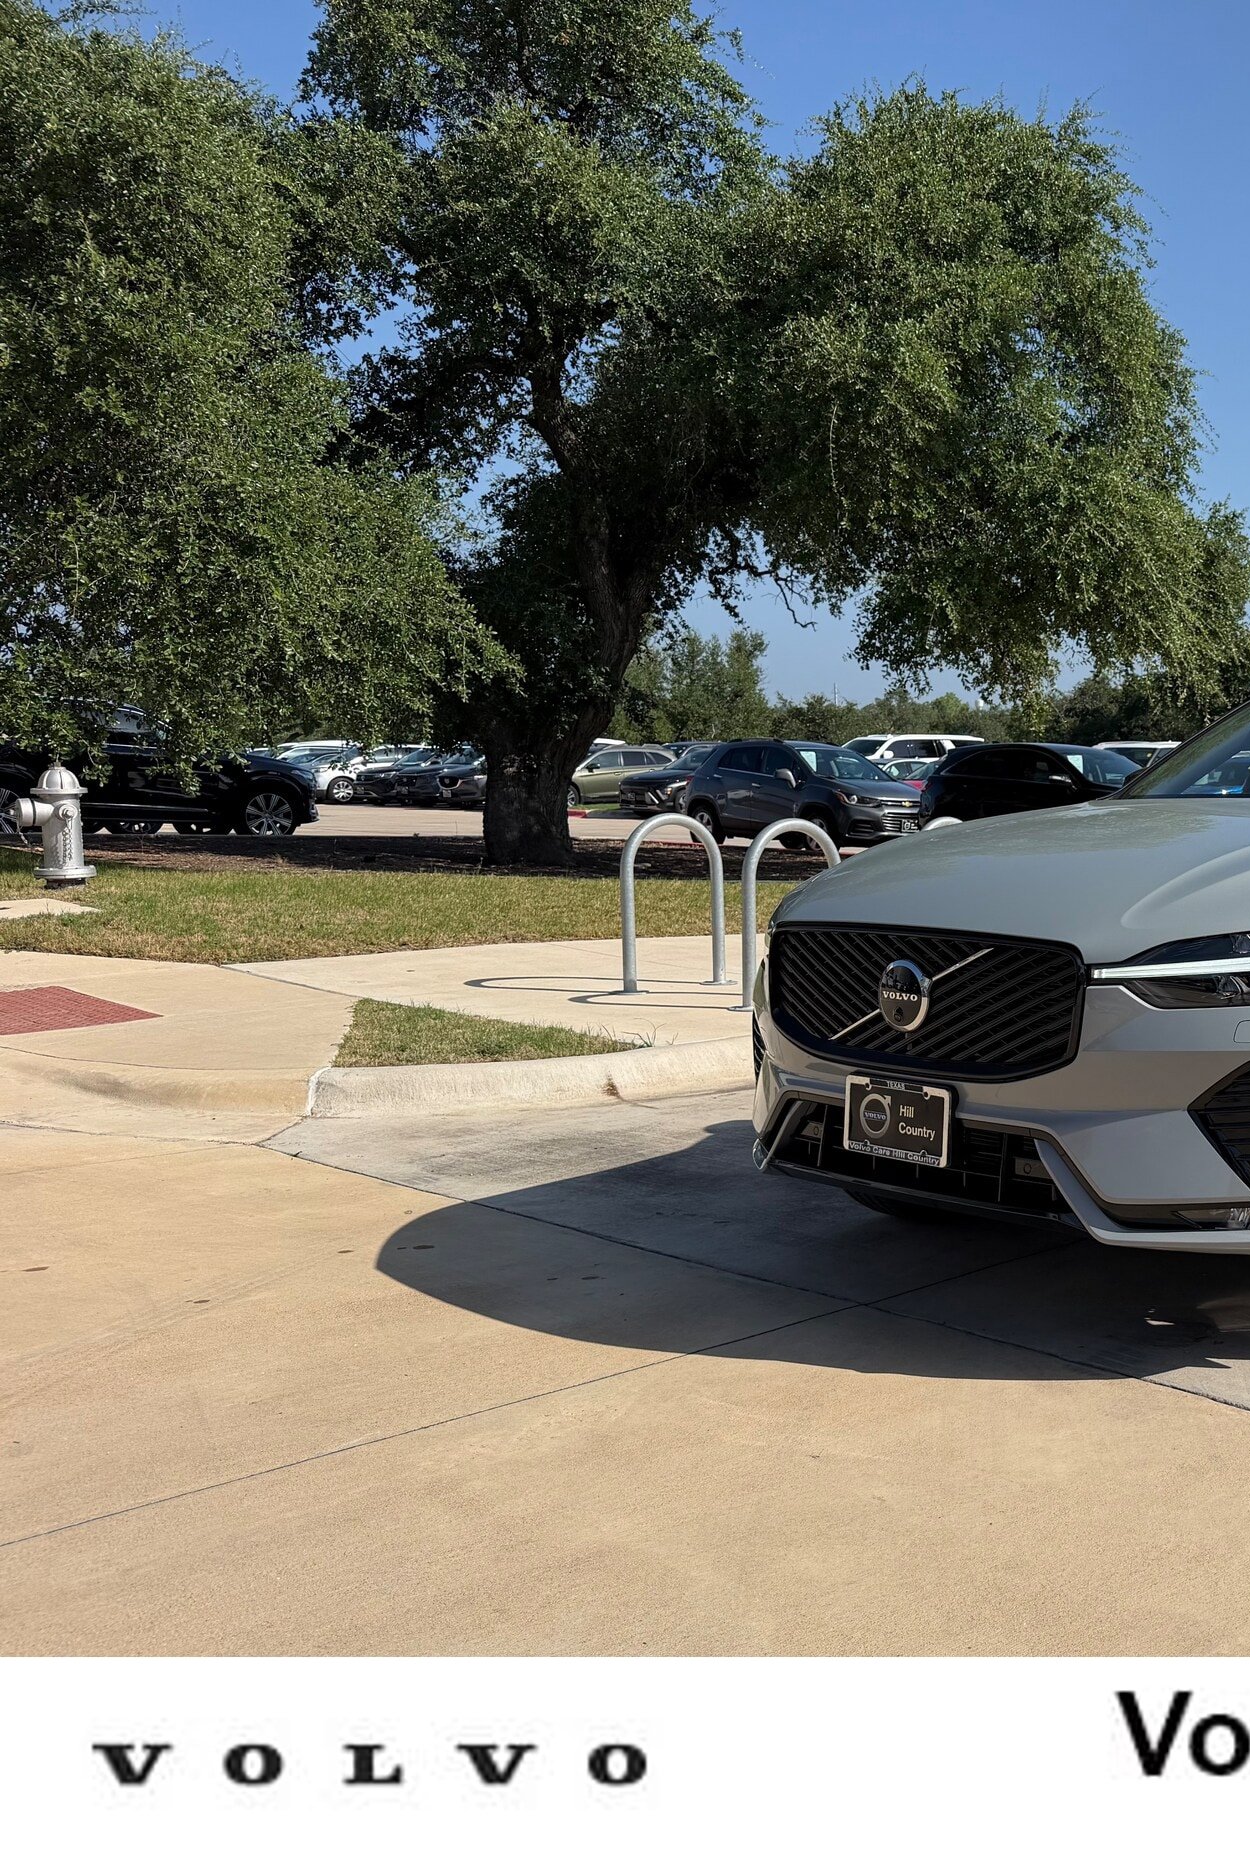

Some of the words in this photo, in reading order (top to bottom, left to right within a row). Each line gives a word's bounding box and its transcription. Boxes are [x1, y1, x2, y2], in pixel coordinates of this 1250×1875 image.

[882, 990, 918, 1002] VOLVO
[886, 1080, 906, 1091] TEXAS
[864, 1111, 887, 1121] VOLVO
[899, 1104, 915, 1118] Hill
[898, 1122, 936, 1141] Country
[849, 1141, 871, 1152] Volvo
[892, 1149, 906, 1160] Hill
[907, 1152, 940, 1166] Country
